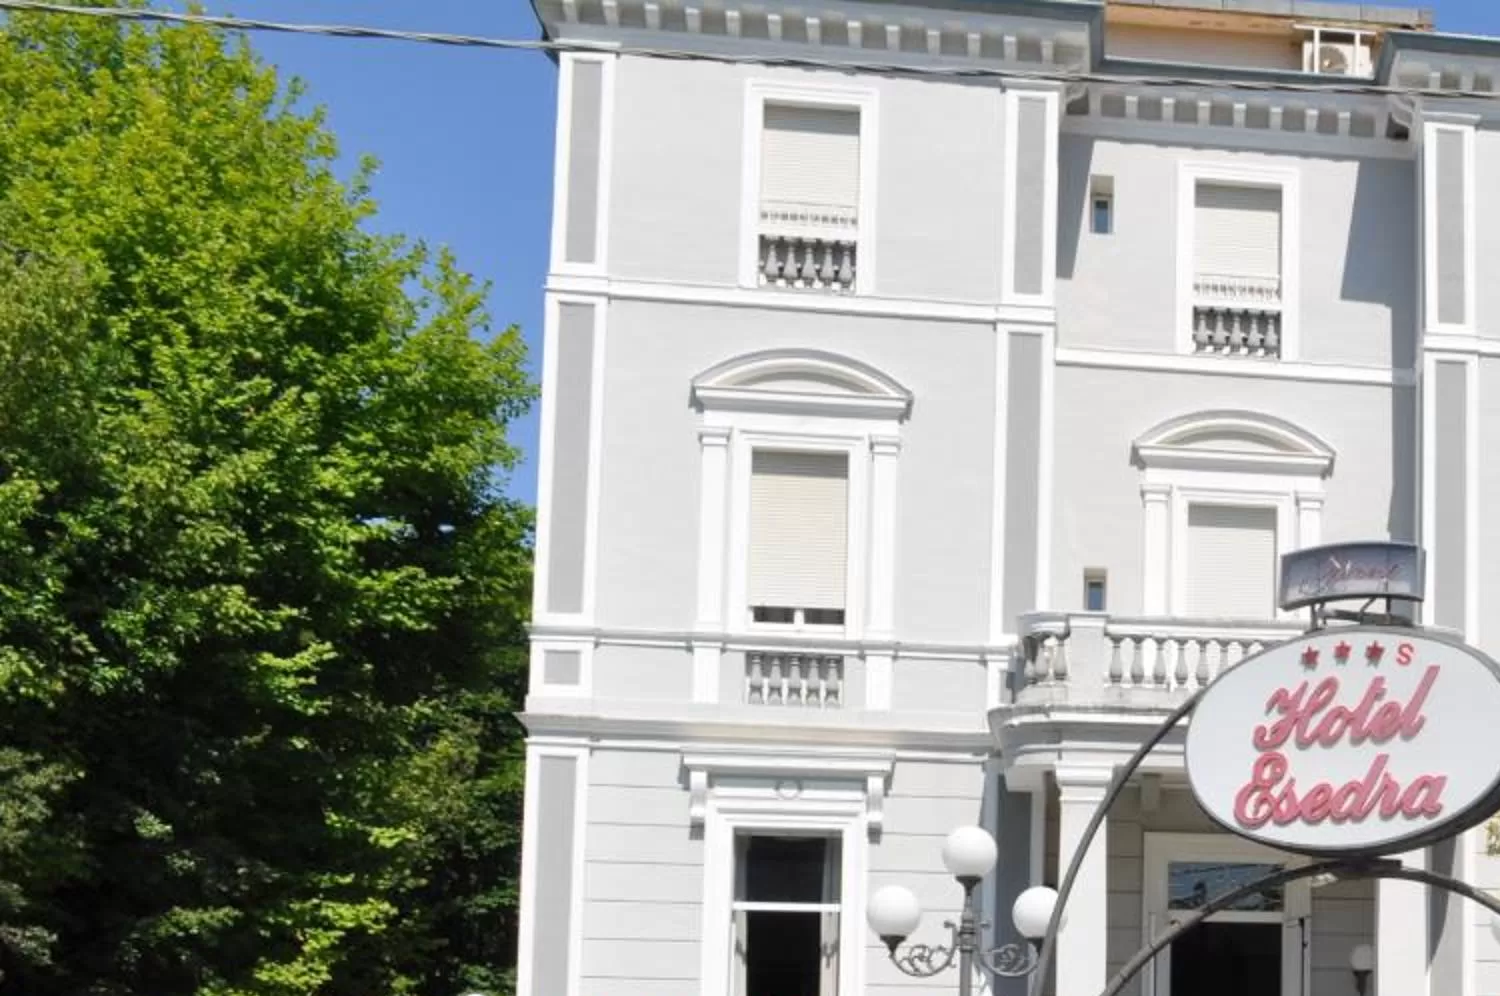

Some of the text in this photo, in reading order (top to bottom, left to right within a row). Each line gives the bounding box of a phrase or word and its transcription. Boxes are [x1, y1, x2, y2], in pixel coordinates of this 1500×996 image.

[1396, 643, 1414, 666] S
[1253, 665, 1440, 748] Hotel
[1234, 751, 1447, 828] Esedra
